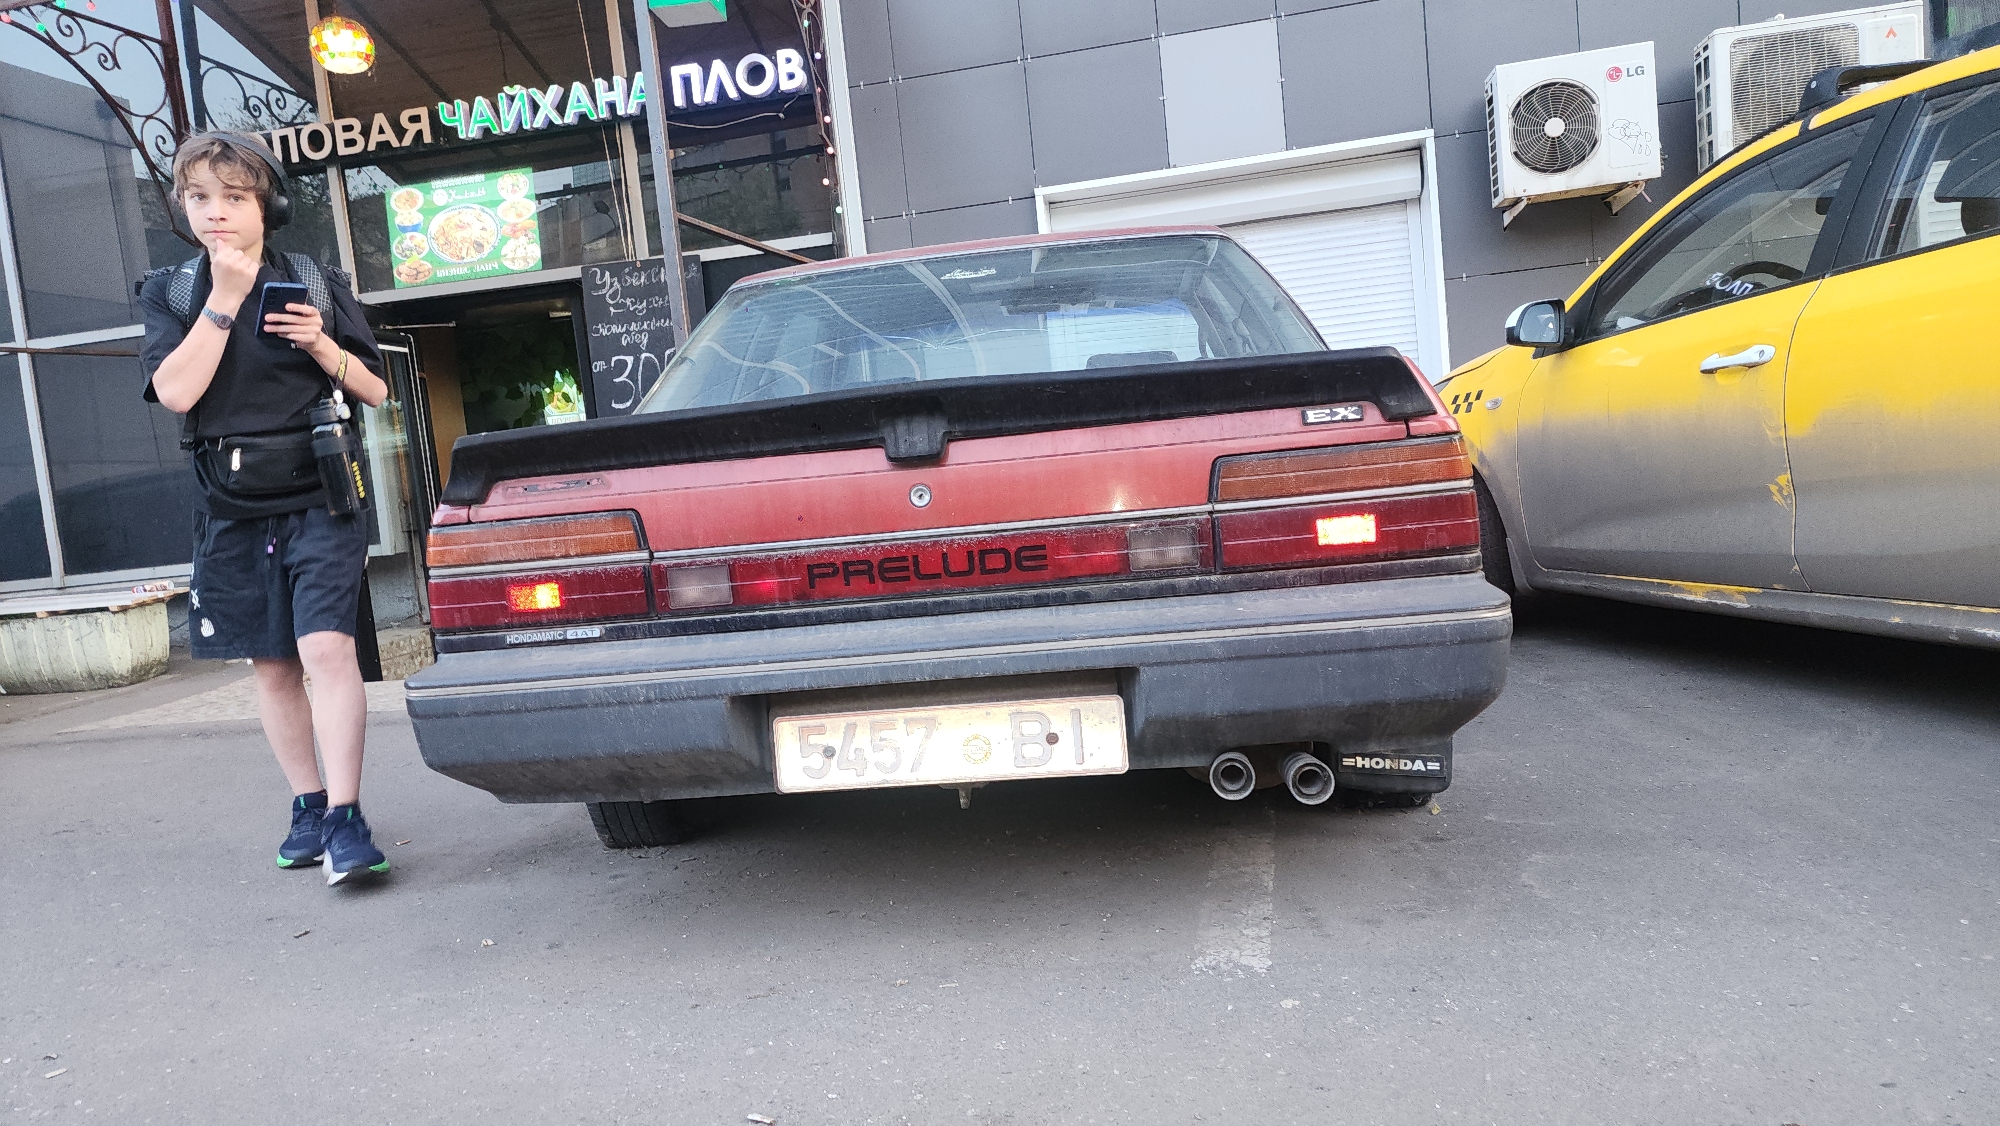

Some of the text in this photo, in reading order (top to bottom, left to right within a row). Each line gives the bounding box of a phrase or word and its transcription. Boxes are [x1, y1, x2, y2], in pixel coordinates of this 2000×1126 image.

[1625, 65, 1645, 78] LG
[249, 48, 808, 164] ЛОВАЯ ЧАЙХАНА ПЛОВ
[1305, 406, 1362, 423] EX
[806, 544, 1049, 590] PRELUDE
[506, 629, 598, 645] HONDAMATIC 4AT
[798, 717, 939, 780] 5457
[1355, 756, 1427, 772] HONDA
